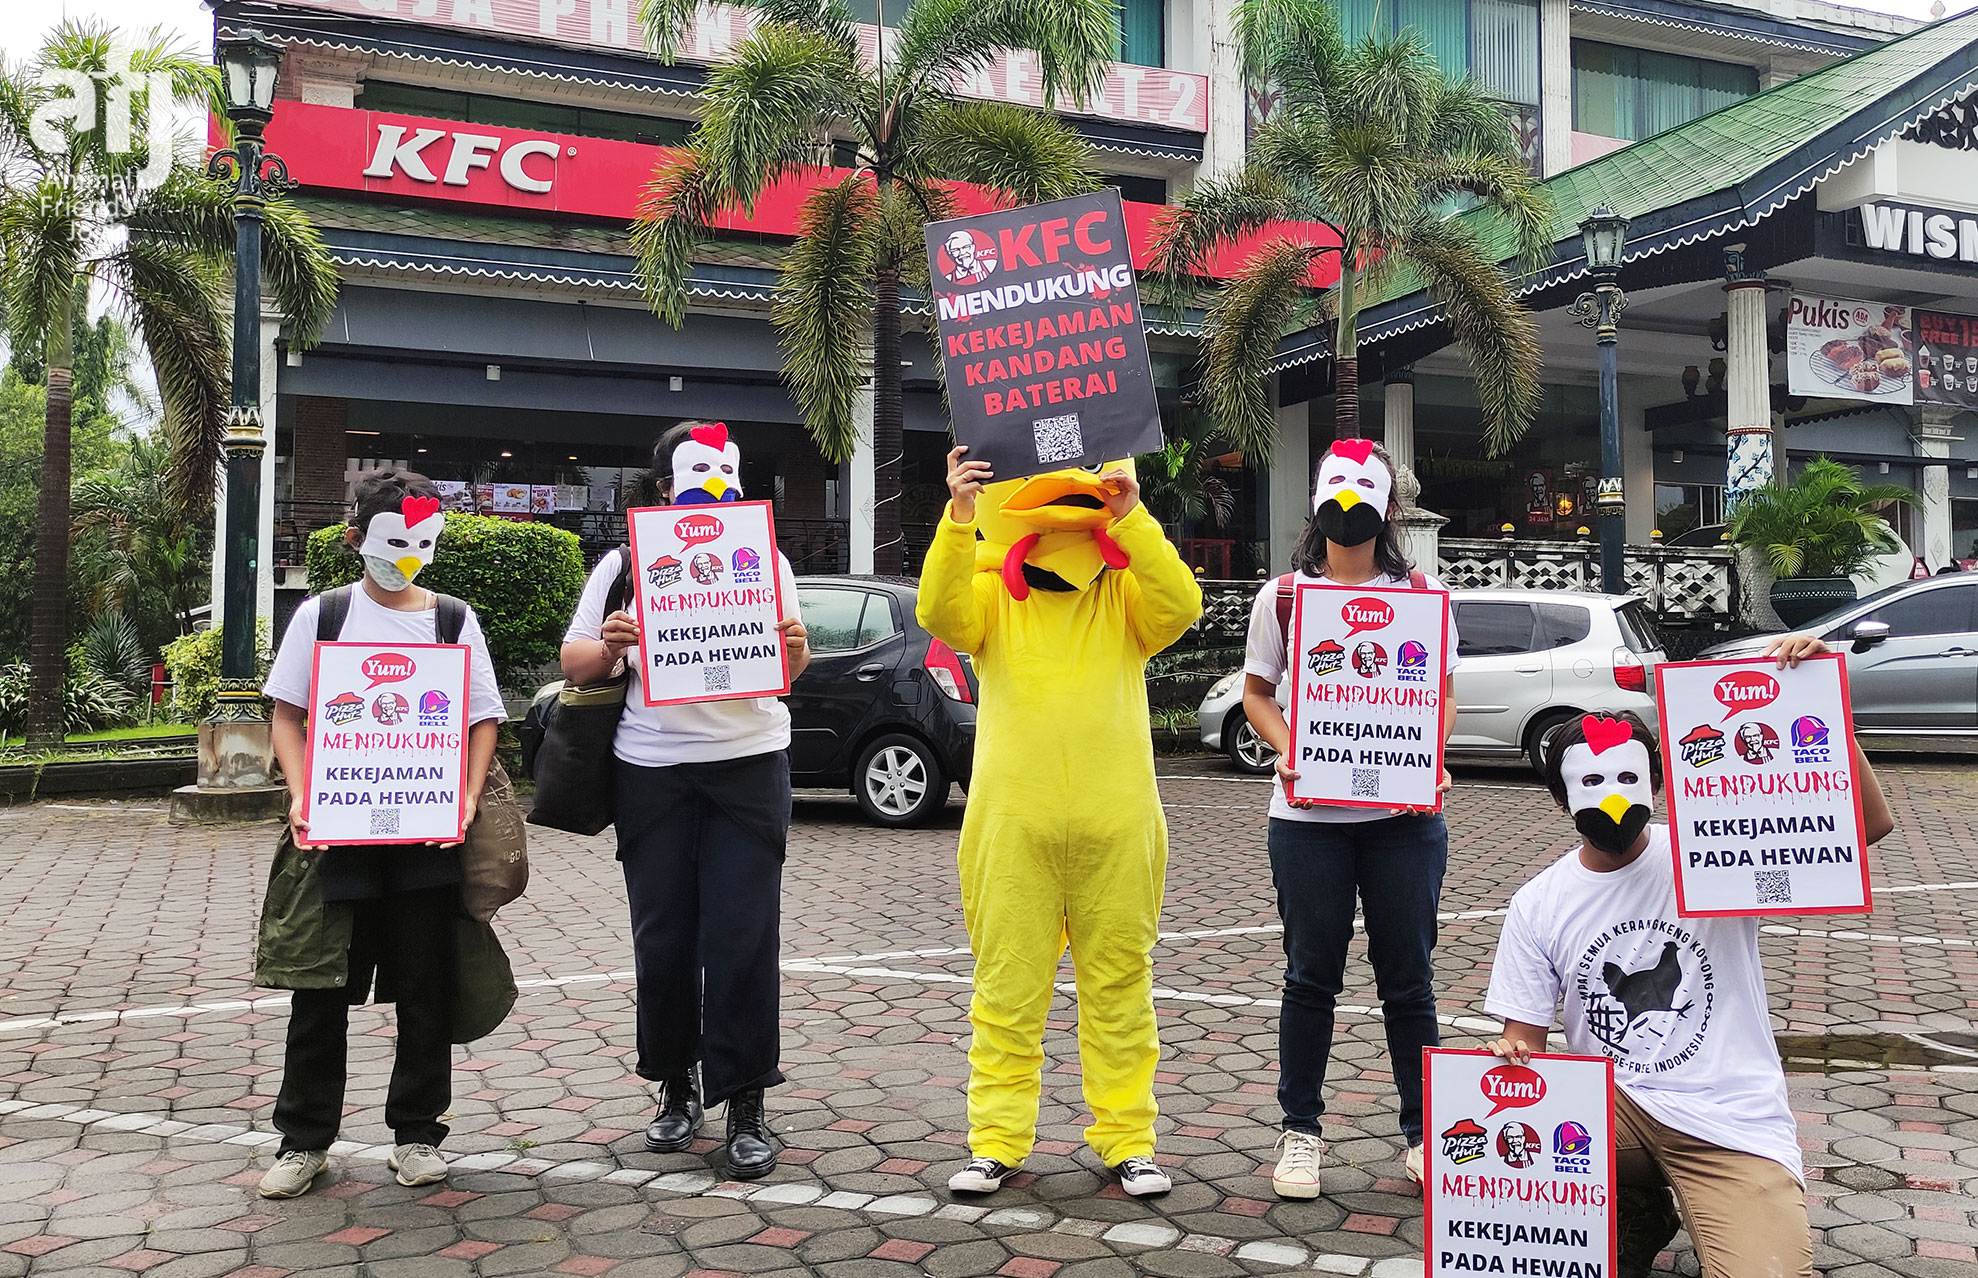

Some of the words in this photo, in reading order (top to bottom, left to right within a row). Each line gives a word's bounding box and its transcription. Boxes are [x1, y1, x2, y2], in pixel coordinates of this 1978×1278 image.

[363, 123, 561, 194] KFC
[998, 211, 1112, 272] KFC
[976, 247, 996, 258] KFC
[938, 263, 1132, 321] MENDUKUNG
[1788, 297, 1850, 330] Pukis
[1920, 315, 1957, 330] BUY
[948, 302, 1134, 357] KEKEJAMAN
[1920, 329, 1959, 345] FREE
[965, 336, 1127, 387] KANDANG
[983, 370, 1118, 416] BATERAI
[677, 521, 720, 538] Yum!
[649, 565, 683, 582] Pizza
[656, 574, 681, 585] Hut
[650, 588, 774, 613] MENDUKUNG
[1345, 605, 1390, 623] Yum!
[658, 622, 764, 643] KEKEJAMAN
[654, 651, 704, 667] PADA
[709, 645, 776, 662] HEWAN
[1309, 651, 1345, 669] Pizza
[1316, 660, 1342, 671] Hut
[365, 660, 413, 676] Yum!
[1307, 683, 1437, 709] MENDUKUNG
[1718, 679, 1775, 702] Yum!
[328, 702, 365, 718] Pizza
[334, 711, 362, 721] Hut
[1310, 721, 1422, 741] KEKEJAMAN
[323, 732, 460, 752] MENDUKUNG
[1682, 737, 1725, 761] Pizza
[1791, 748, 1830, 756] TACO
[1303, 747, 1353, 764] PADA
[1360, 750, 1432, 768] HEWAN
[1691, 748, 1722, 763] Hut
[326, 767, 443, 784] KEKEJAMAN
[1684, 770, 1849, 800] MENDUKUNG
[318, 792, 372, 805] PADA
[379, 791, 454, 804] HEWAN
[1693, 815, 1835, 840] KEKEJAMAN
[1688, 850, 1754, 868] PADA
[1761, 846, 1853, 866] HEWAN
[1579, 932, 1612, 970] SEMUA
[1612, 918, 1691, 944] KERANGKENG
[1689, 940, 1715, 990] KOSONG
[1654, 1032, 1705, 1073] INDONESIA
[1485, 1075, 1542, 1099] Yum!
[1444, 1133, 1487, 1154] Pizza
[1452, 1145, 1483, 1160] Hut
[1552, 1157, 1590, 1165] TACO
[1554, 1166, 1591, 1174] BELL
[1442, 1173, 1606, 1208] MENDUKUNG
[1449, 1220, 1588, 1247] KEKEJAMAN
[1441, 1251, 1504, 1273] PADA
[1512, 1257, 1602, 1278] HEWAN
